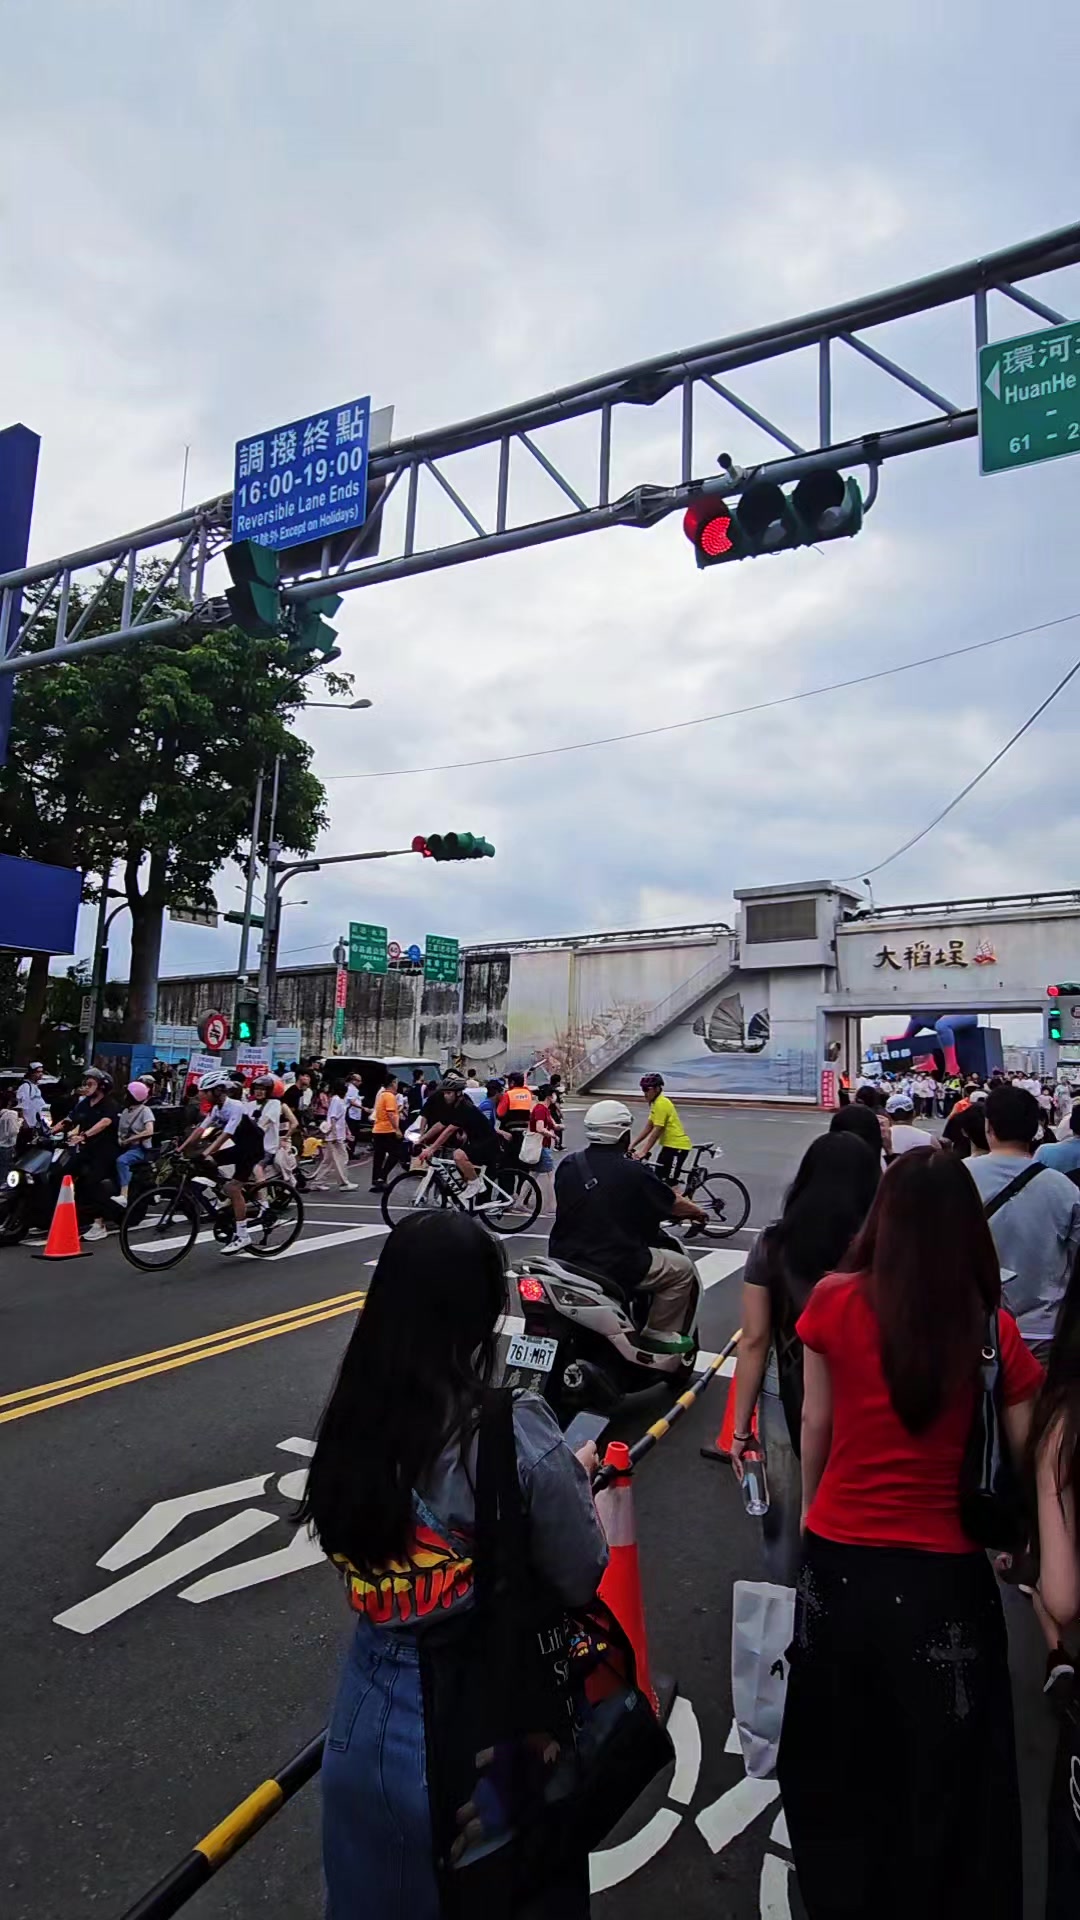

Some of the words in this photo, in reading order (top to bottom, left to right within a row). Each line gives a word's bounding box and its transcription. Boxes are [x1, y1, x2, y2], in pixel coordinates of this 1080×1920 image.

[1005, 372, 1077, 404] HuanHe
[239, 406, 365, 478] 調撥終點
[1009, 434, 1031, 453] 61
[238, 446, 363, 508] 16:00-19:00
[237, 501, 295, 533] Reversible
[298, 491, 326, 514] Lane
[329, 480, 360, 504] Ends
[280, 523, 307, 540] Except
[307, 521, 319, 531] on
[319, 504, 359, 527] Holidays)
[873, 939, 969, 971] 大稻埕
